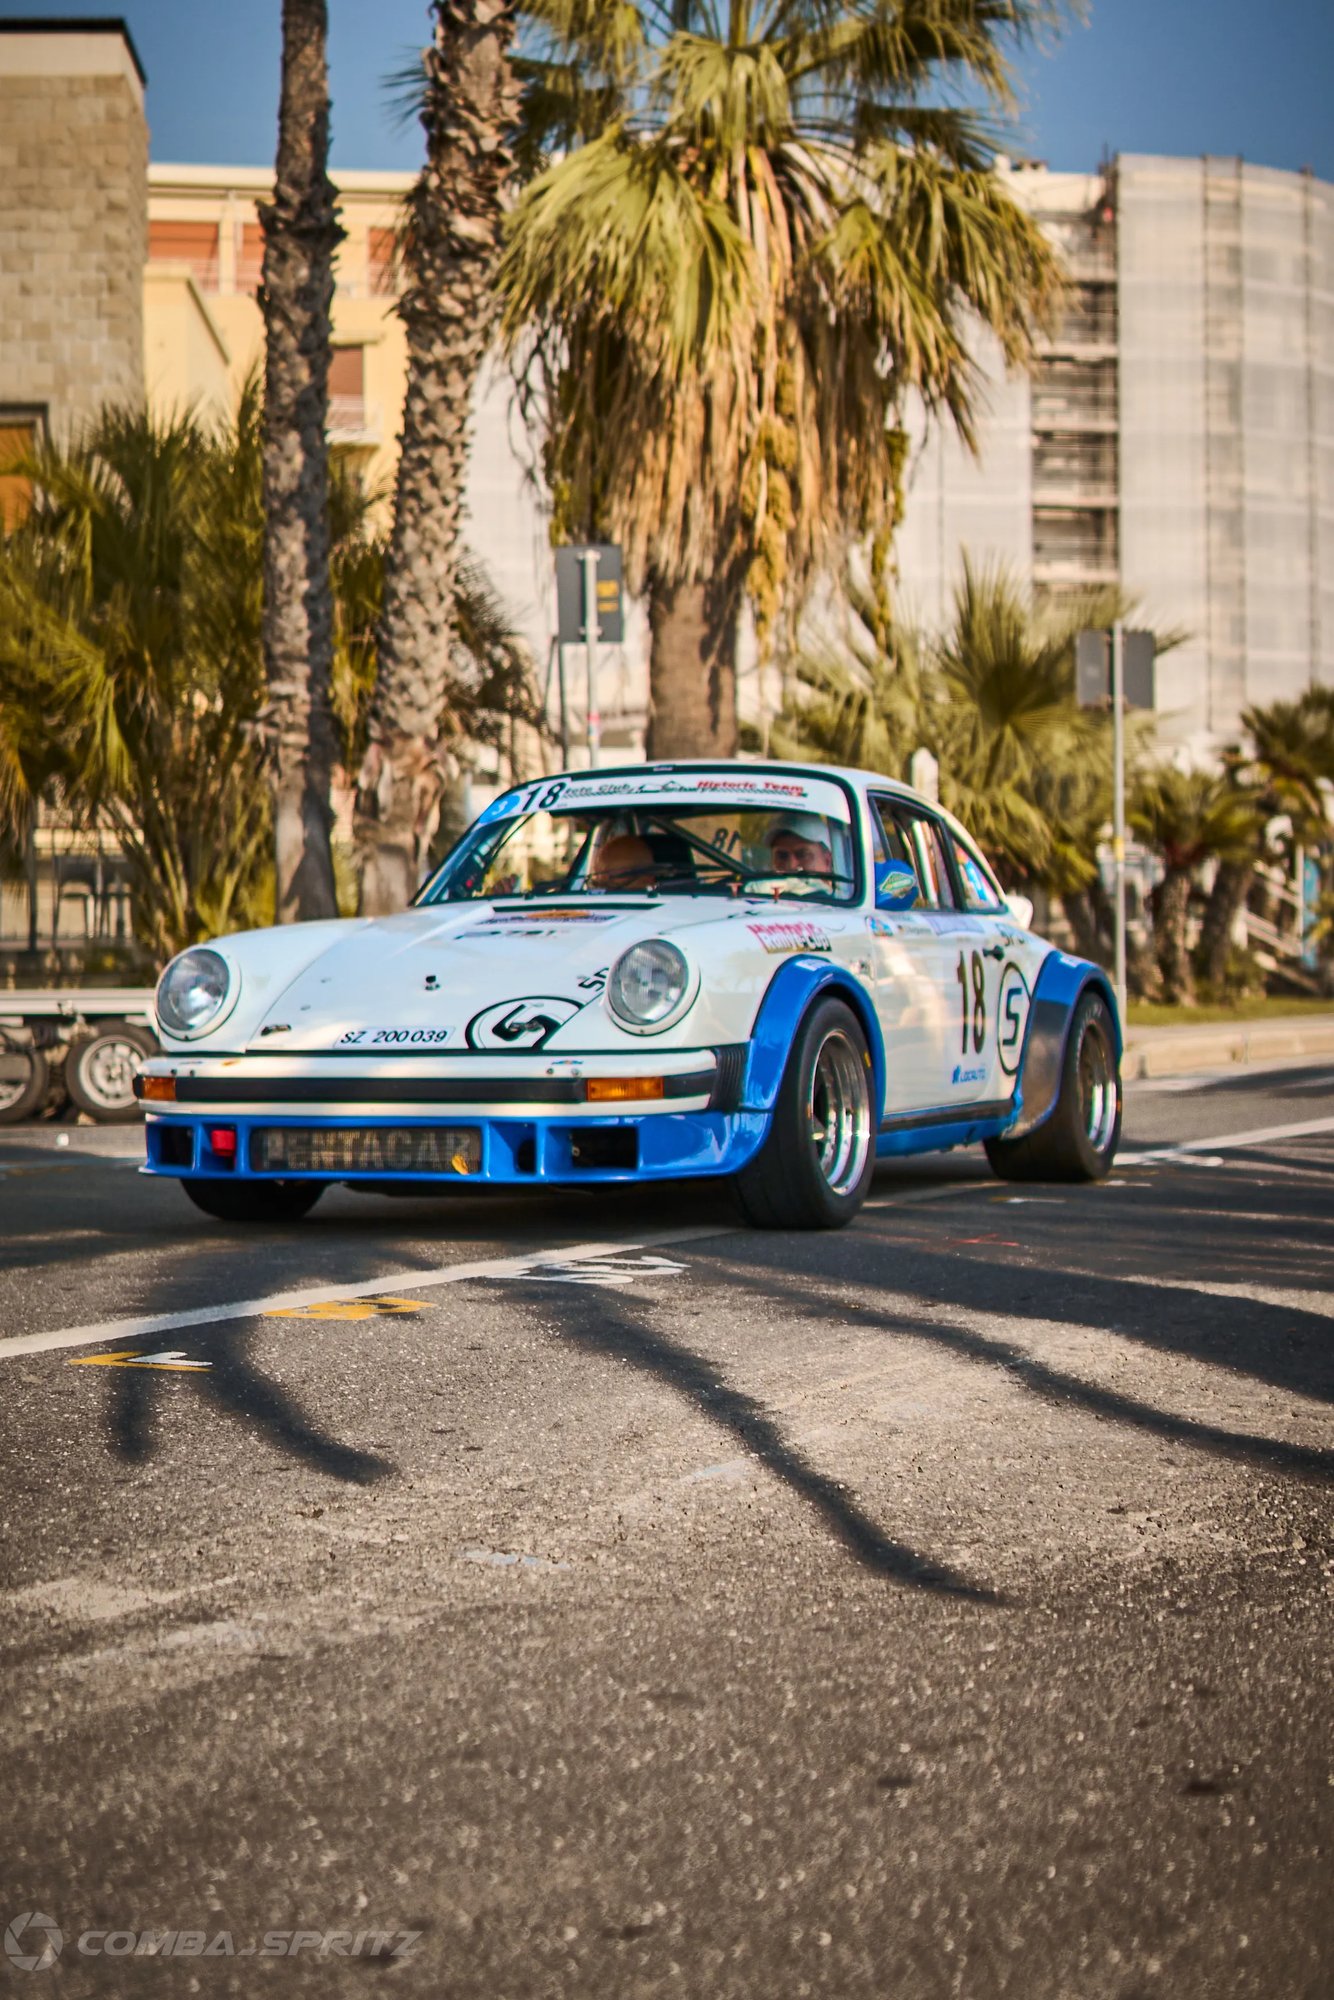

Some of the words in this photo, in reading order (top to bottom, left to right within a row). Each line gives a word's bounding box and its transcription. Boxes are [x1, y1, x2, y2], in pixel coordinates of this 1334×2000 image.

[522, 782, 567, 812] 18
[697, 780, 756, 790] Historic
[763, 781, 804, 793] Team
[957, 949, 986, 1055] 18
[340, 1030, 369, 1043] SZ
